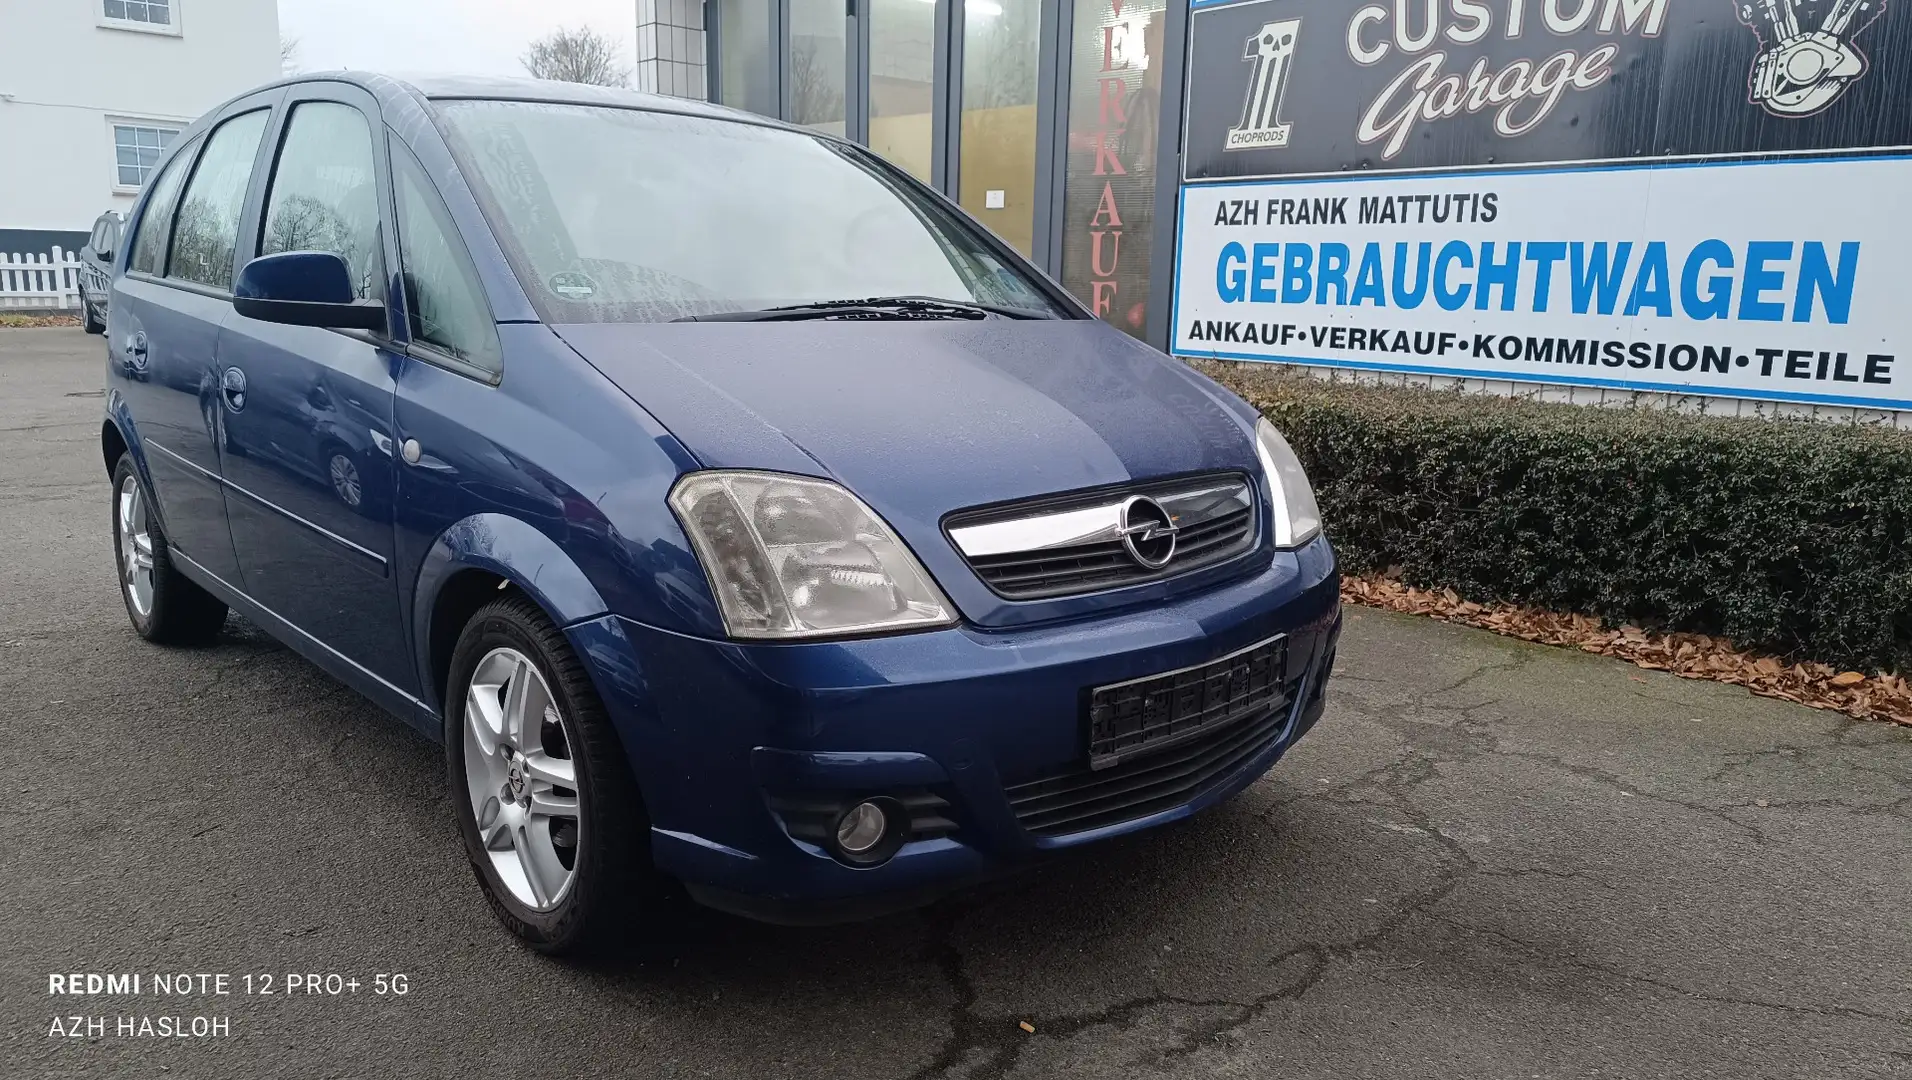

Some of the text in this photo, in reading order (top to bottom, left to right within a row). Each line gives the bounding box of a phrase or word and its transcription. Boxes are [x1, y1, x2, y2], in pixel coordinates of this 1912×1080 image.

[1356, 44, 1618, 158] Garage
[1231, 130, 1285, 144] CHOPRODS
[1214, 192, 1498, 226] AZH FRANK MATTUTIS
[1216, 239, 1861, 325] GEBRAUCHTWAGEN
